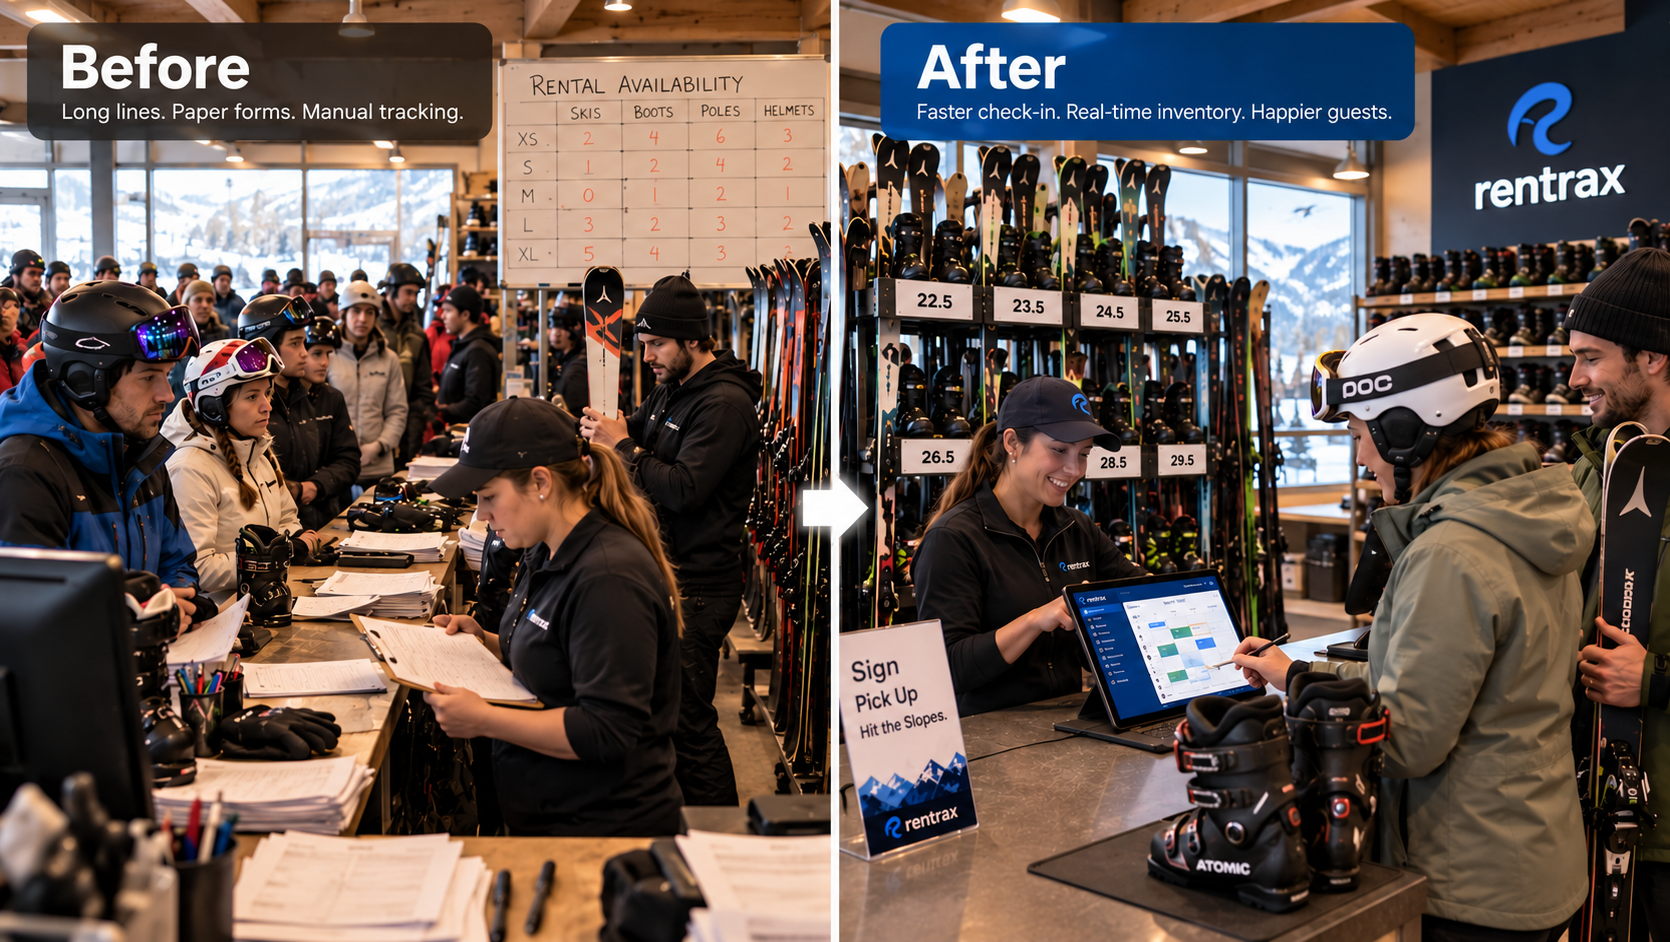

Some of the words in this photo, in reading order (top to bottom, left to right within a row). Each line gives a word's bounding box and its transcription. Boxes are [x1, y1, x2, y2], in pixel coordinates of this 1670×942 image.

[529, 74, 606, 96] RENTAL
[618, 75, 744, 94] AVAILABILITY
[570, 106, 601, 121] SKIS
[633, 105, 674, 120] BOOTS
[701, 103, 741, 117] POLES
[764, 104, 815, 117] HELMETS
[518, 132, 538, 147] XS
[583, 131, 595, 146] 2
[649, 131, 659, 146] 4
[716, 128, 726, 144] 6
[783, 127, 793, 143] 3
[523, 159, 533, 176] S
[649, 158, 660, 173] 2
[715, 157, 725, 173] 4
[782, 156, 794, 172] 2
[521, 188, 535, 203] M
[582, 187, 595, 203] 0
[716, 186, 727, 202] 2
[1474, 164, 1626, 211] rentrax
[523, 217, 534, 233] L
[583, 216, 594, 233] 3
[650, 216, 661, 232] 2
[716, 215, 726, 232] 3
[782, 215, 794, 231] 2
[518, 247, 539, 262] XL
[584, 245, 595, 262] 5
[649, 246, 660, 262] 4
[717, 245, 727, 261] 3
[917, 292, 953, 310] 22.5
[1012, 298, 1045, 315] 23.5
[1096, 304, 1124, 320] 24.5
[1166, 309, 1191, 324] 25.5
[921, 450, 955, 464] 26.5
[1100, 456, 1127, 470] 28.5
[1170, 454, 1195, 467] 29.5
[851, 659, 900, 684] Sign
[855, 690, 892, 713] Pick
[894, 686, 918, 707] Up
[859, 722, 880, 739] Hit
[880, 720, 902, 735] the
[903, 711, 948, 729] Slopes.
[904, 806, 959, 832] rentrax
[1196, 859, 1251, 876] ATOMIC
